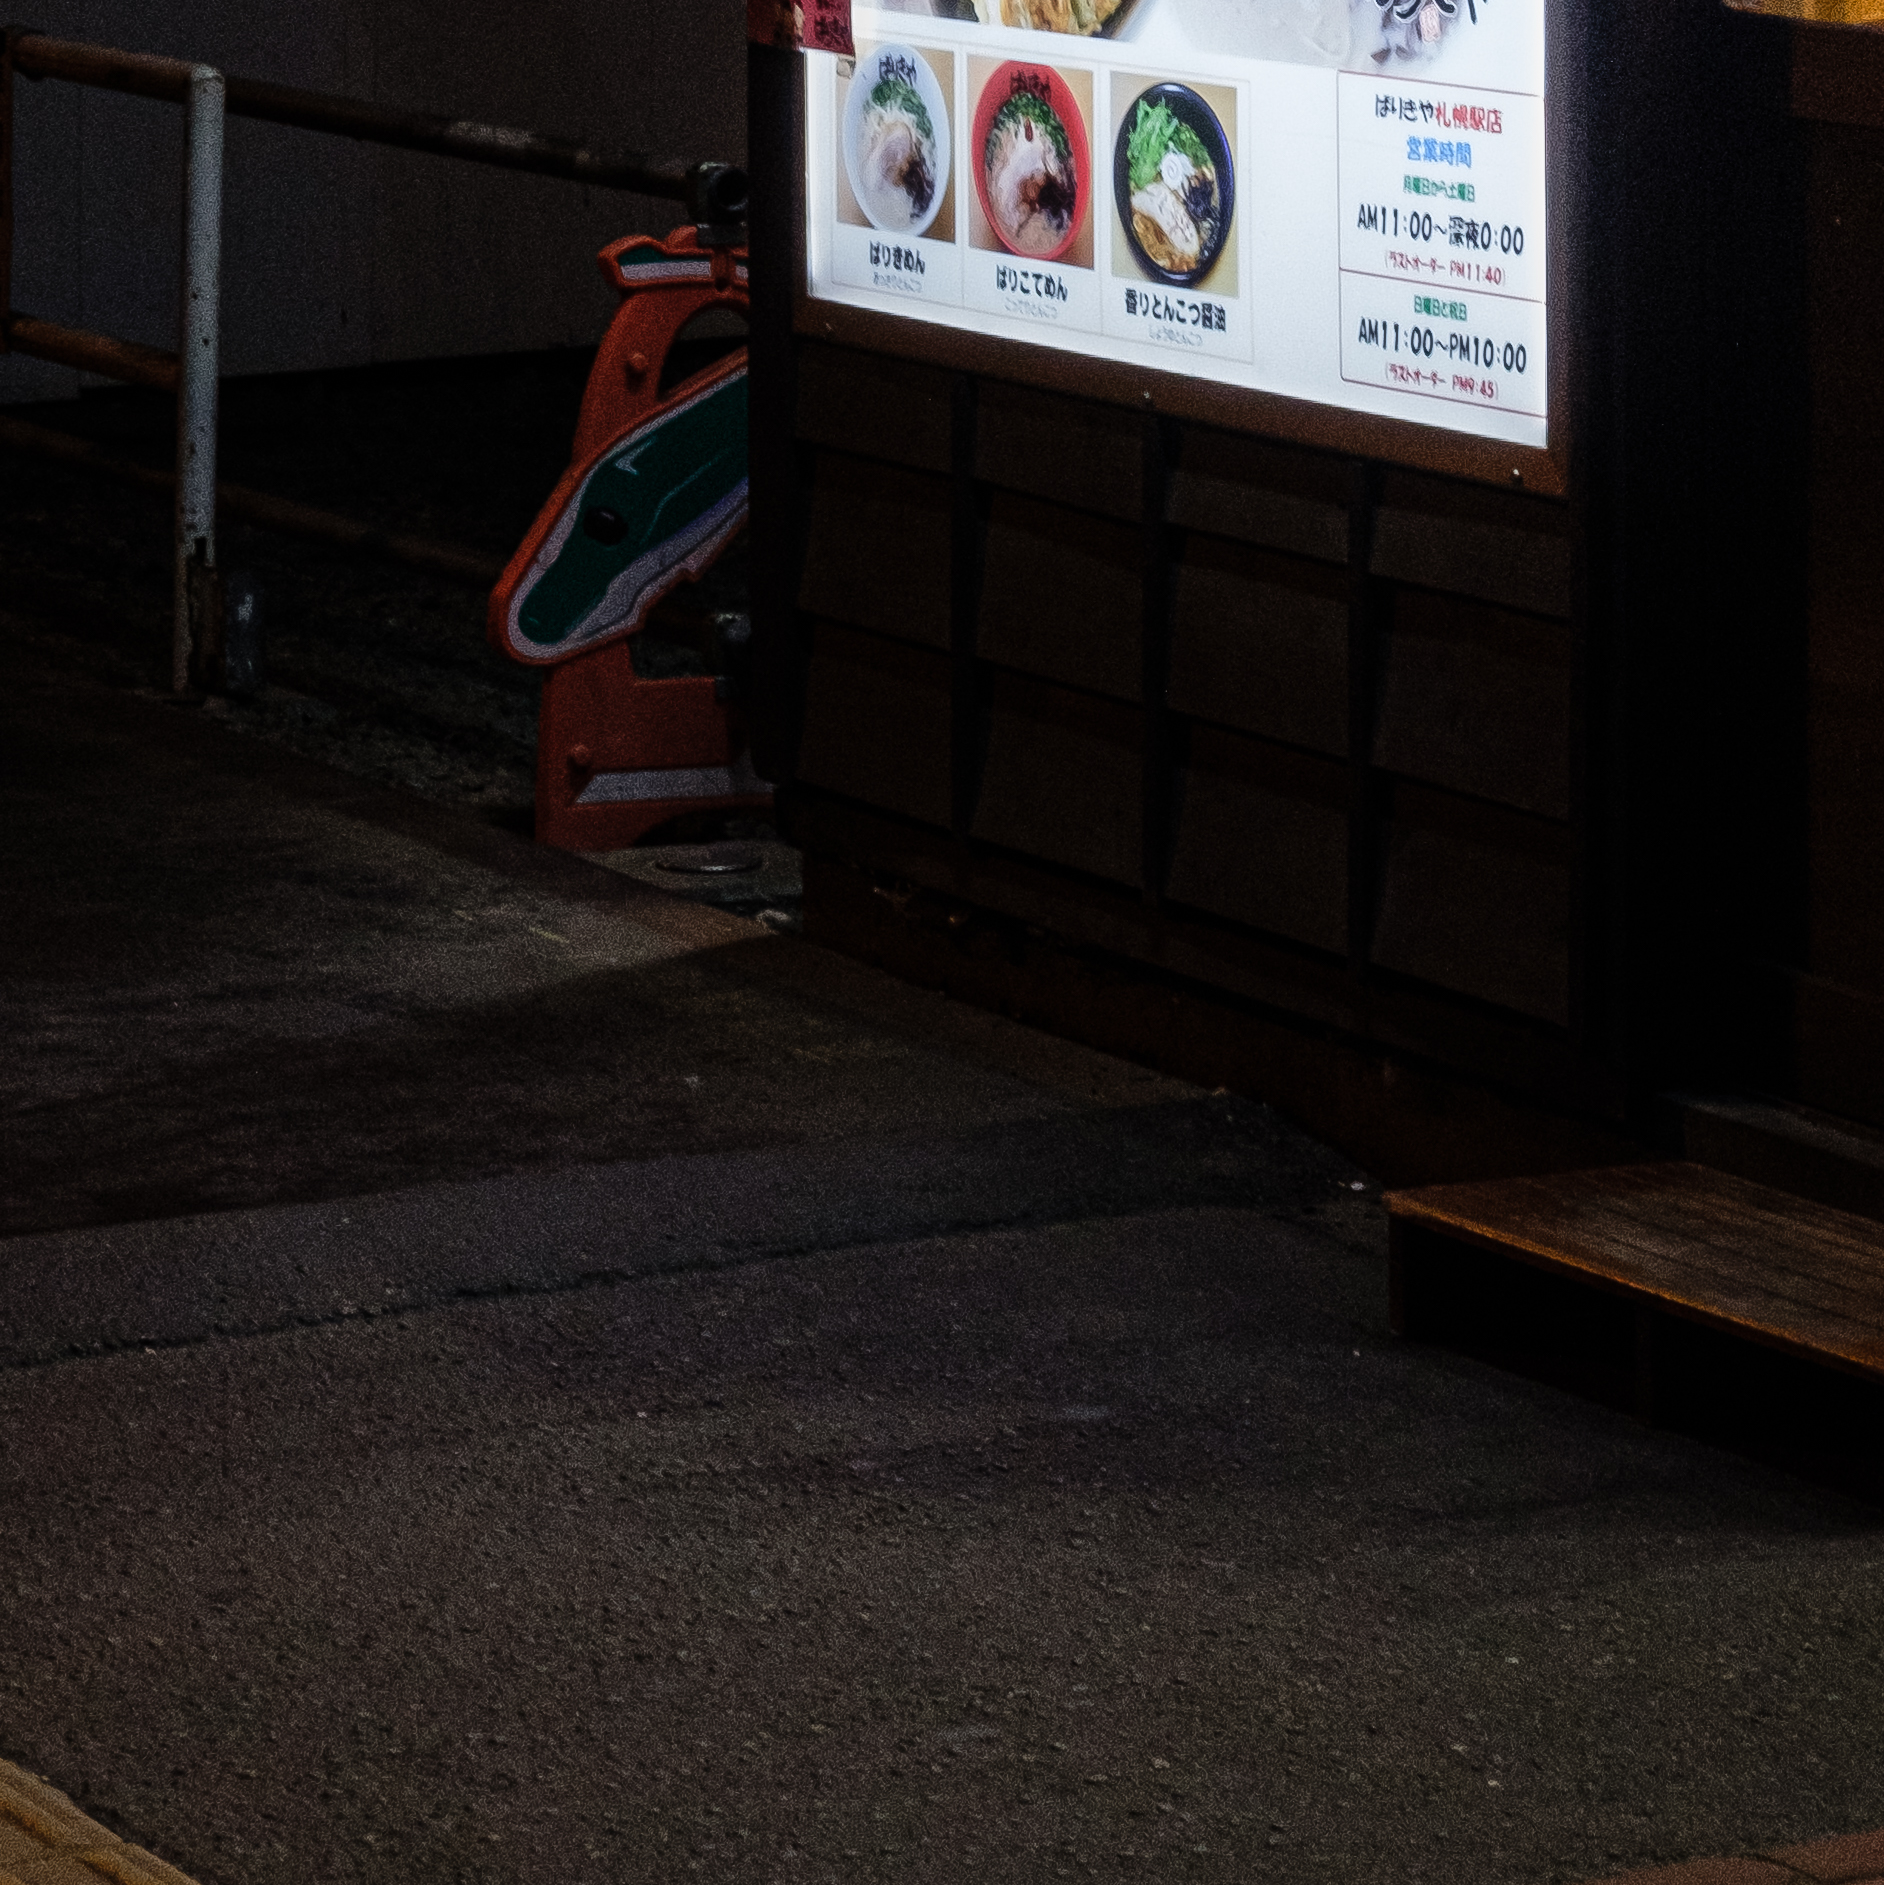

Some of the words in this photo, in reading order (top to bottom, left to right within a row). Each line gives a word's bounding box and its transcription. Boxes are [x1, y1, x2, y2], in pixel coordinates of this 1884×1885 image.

[1406, 135, 1472, 168] 営業時間
[996, 264, 1068, 303] ばりこてめん
